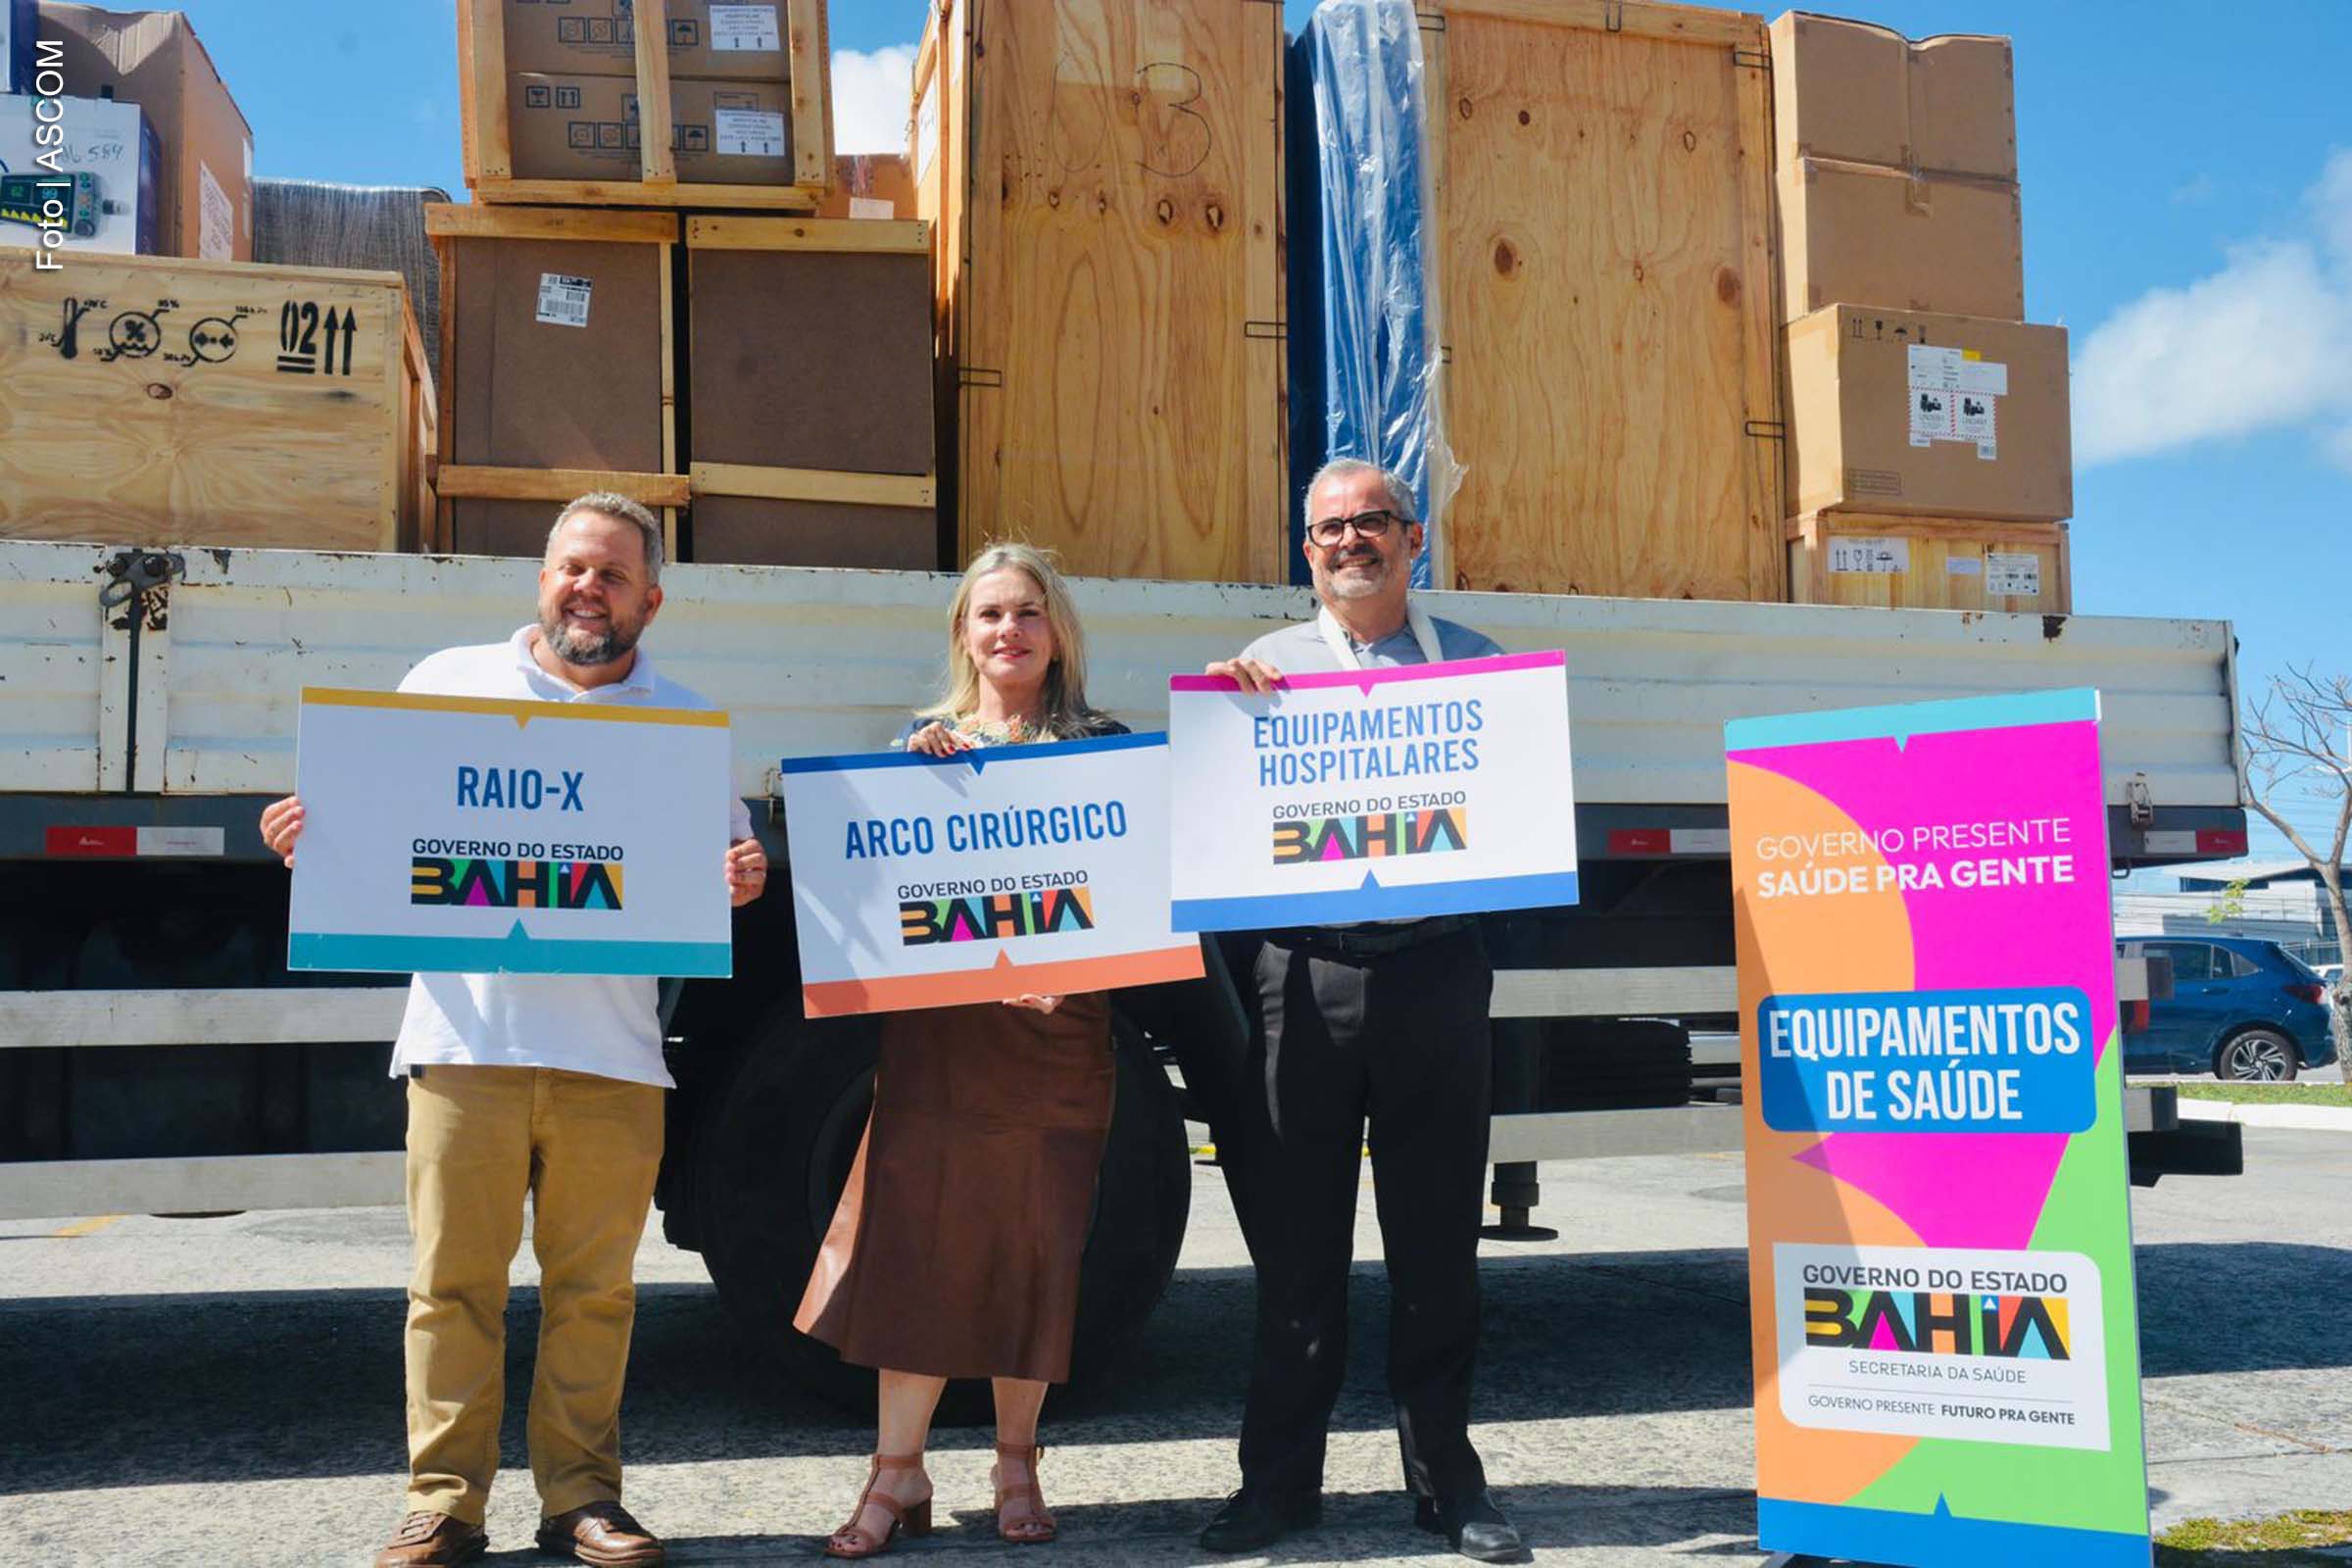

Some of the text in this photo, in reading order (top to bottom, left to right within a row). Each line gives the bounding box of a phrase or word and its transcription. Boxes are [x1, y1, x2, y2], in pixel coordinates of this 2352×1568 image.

[1254, 699, 1483, 749] EQUIPAMENTOS
[1260, 738, 1479, 787] HOSPITALARES
[458, 765, 584, 811] RAIO-X
[1273, 790, 1466, 819] GOVERNO DO ESTADO
[413, 838, 623, 860] GOVERNO DO ESTADO
[845, 800, 1128, 859] ARCO CIRÚRGICO
[1756, 817, 2071, 860] GOVERNO PRESENTE
[898, 870, 1088, 899] GOVERNO DO ESTADO
[1757, 855, 2074, 900] SAÚDE PRA GENTE
[1770, 1003, 2080, 1061] EQUIPAMENTOS
[1827, 1058, 2023, 1121] DE SAÚDE
[1803, 1264, 2068, 1293] GOVERNO DO ESTADO
[1849, 1360, 2026, 1384] SECRETARIA DA SAÚDE
[1808, 1395, 2076, 1425] GOVERNO PRESENTE FUTURO PRA GENTE
